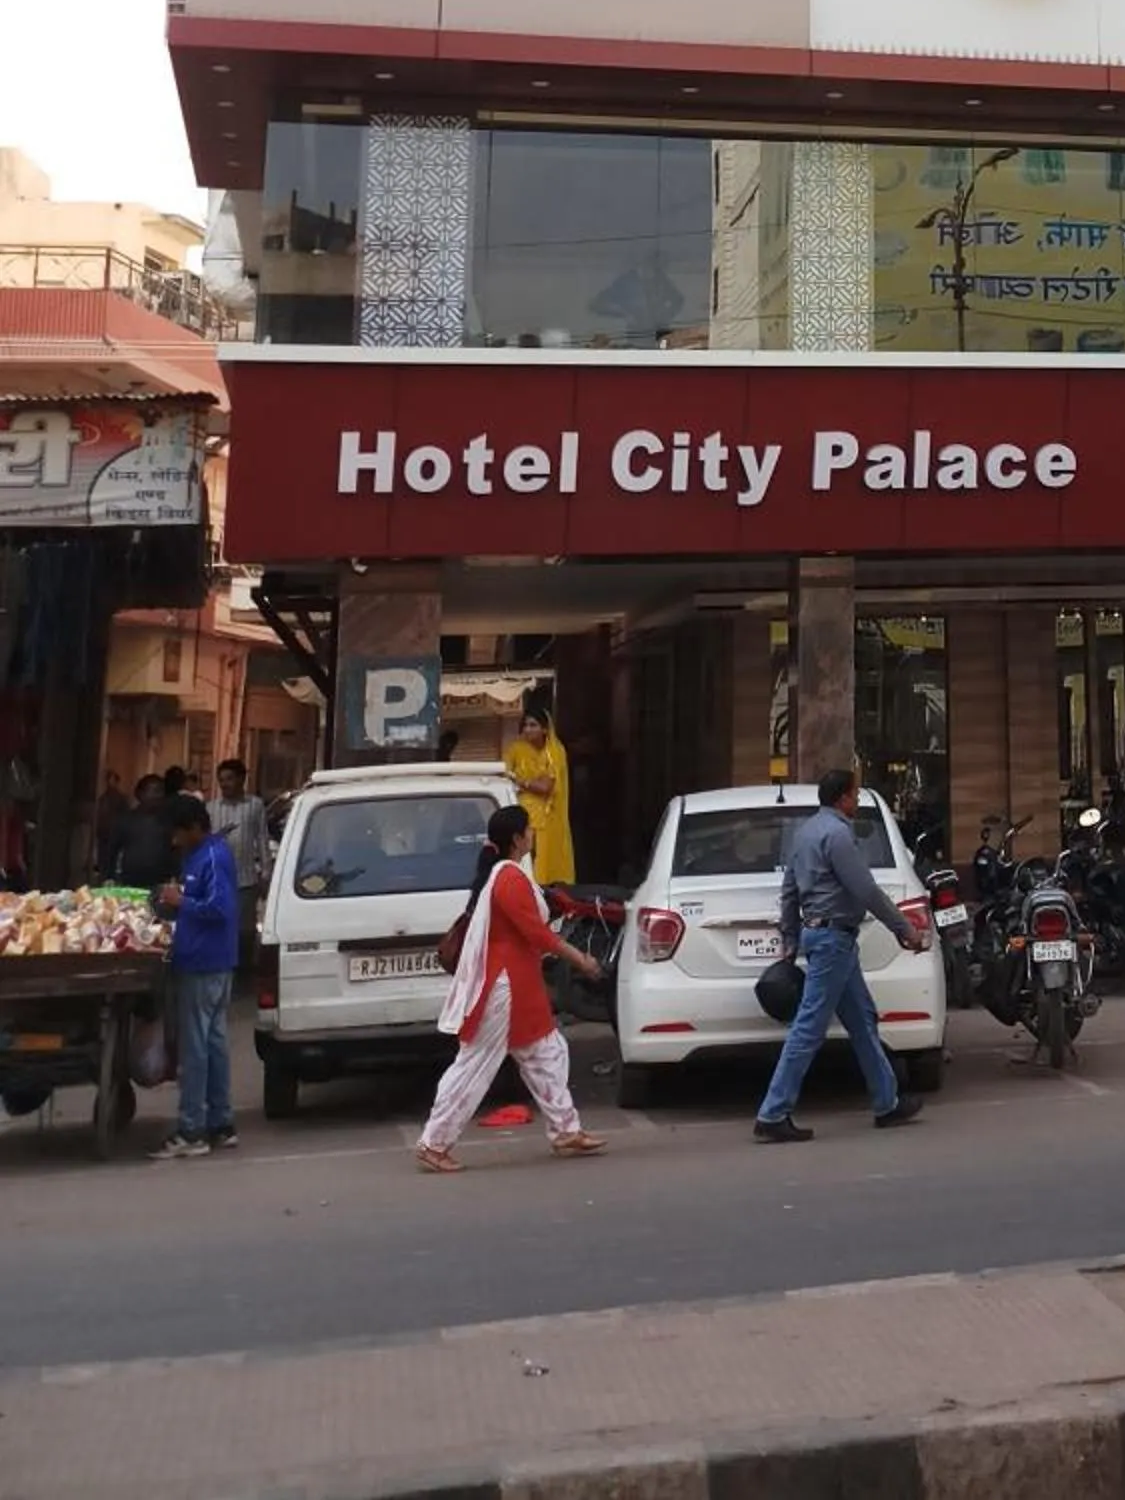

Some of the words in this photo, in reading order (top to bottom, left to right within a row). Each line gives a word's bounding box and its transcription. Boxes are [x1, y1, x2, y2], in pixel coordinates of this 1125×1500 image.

[337, 429, 579, 494] Hotel
[611, 430, 782, 506] City
[811, 430, 1078, 491] Palace
[363, 668, 428, 746] P
